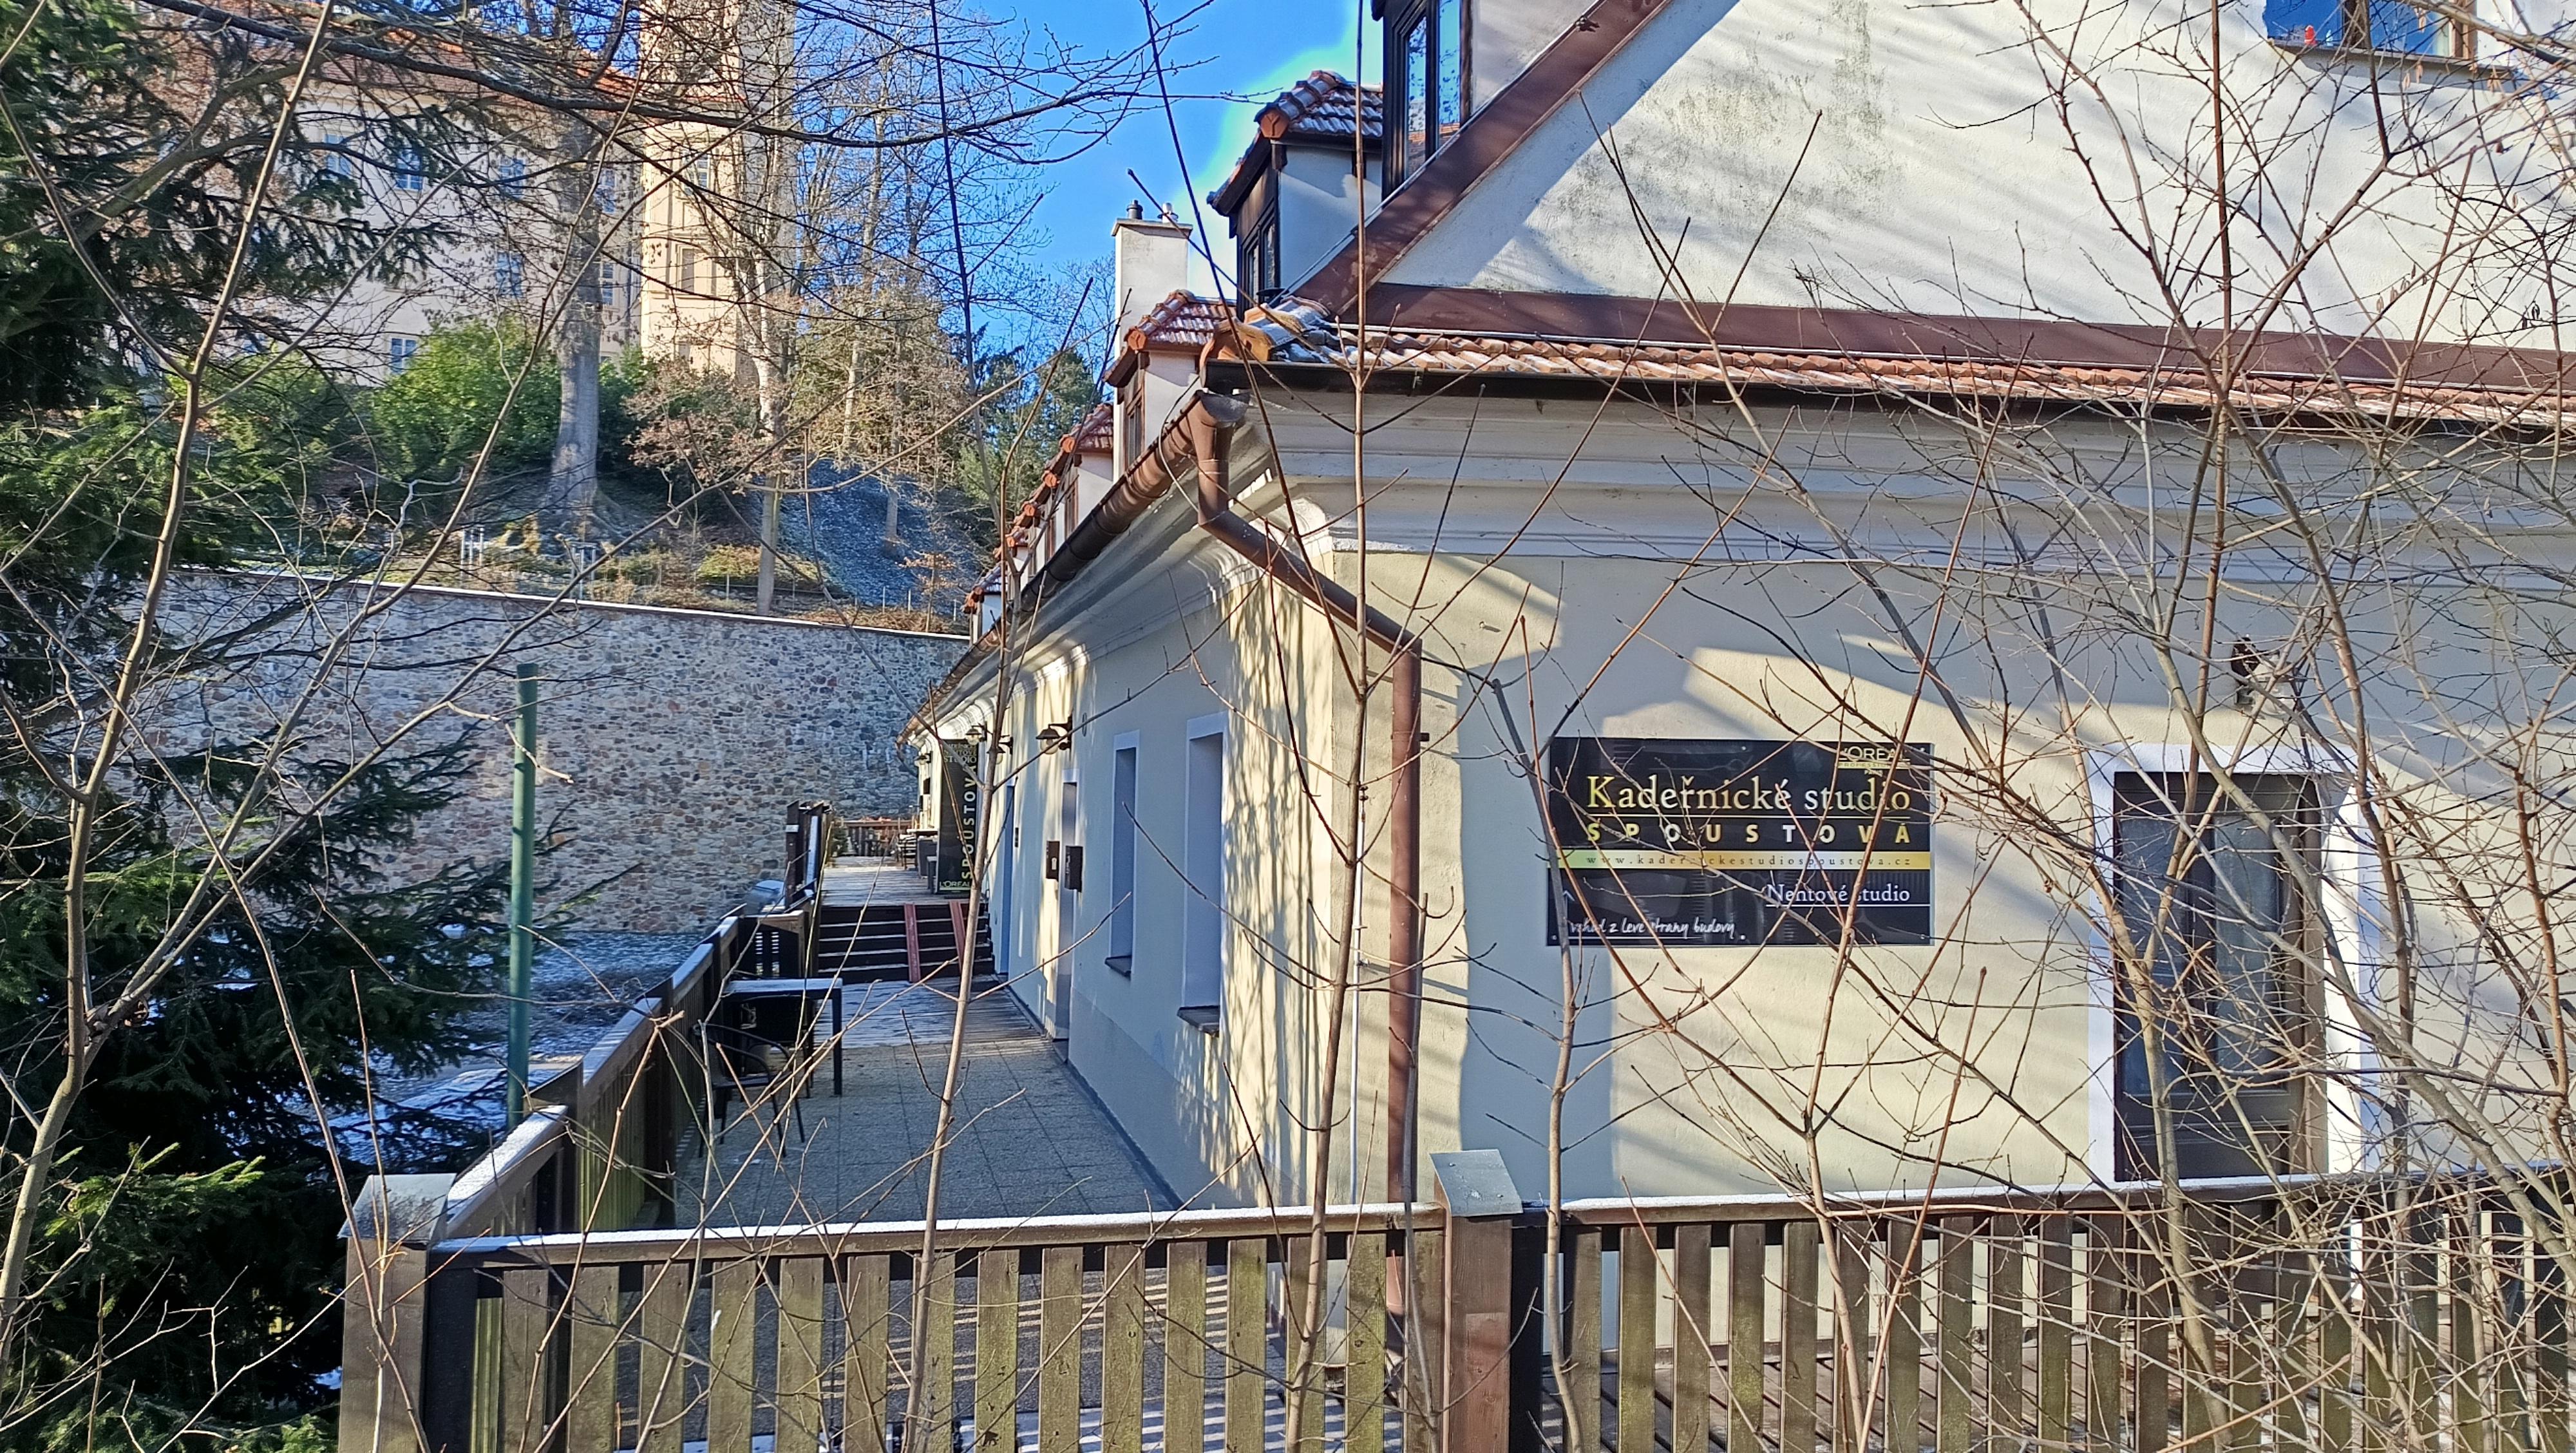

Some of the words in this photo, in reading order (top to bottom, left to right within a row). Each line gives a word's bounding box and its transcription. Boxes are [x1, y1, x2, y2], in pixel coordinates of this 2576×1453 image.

[1587, 775, 1792, 810] Kadeřnické
[1804, 777, 1910, 810] studio
[1586, 823, 1910, 844] SPOUSTOVÁ
[1694, 916, 1735, 940] budovy
